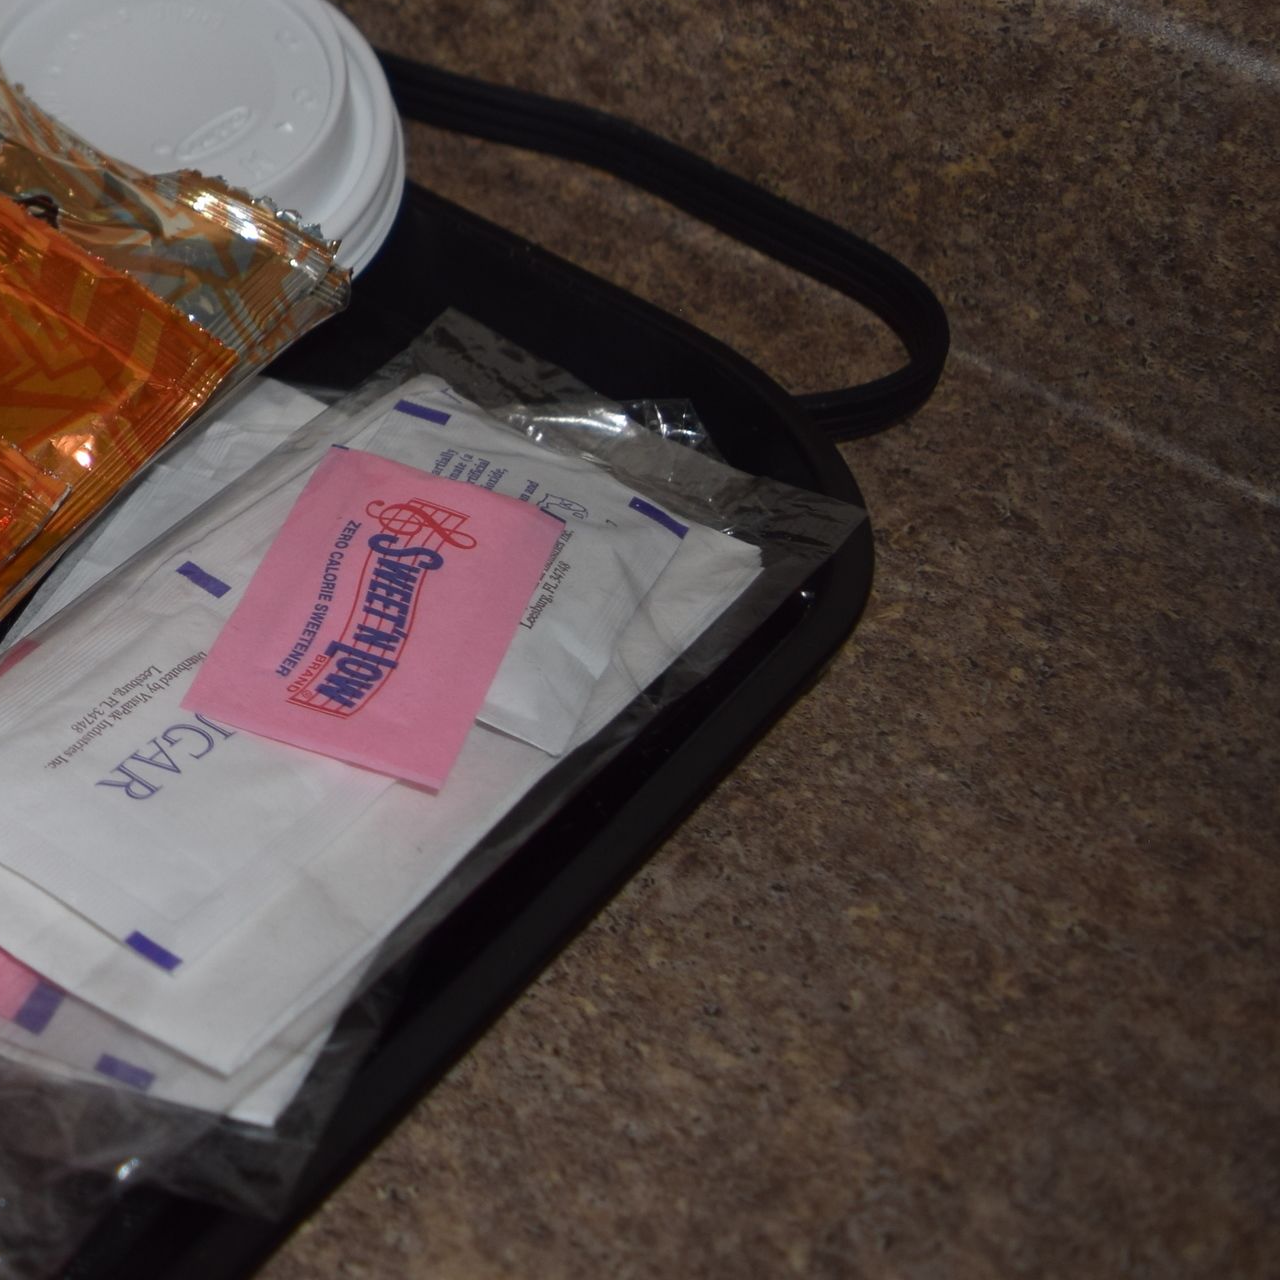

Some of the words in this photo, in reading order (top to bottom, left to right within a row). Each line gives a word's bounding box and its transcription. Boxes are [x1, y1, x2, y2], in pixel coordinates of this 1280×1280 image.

[432, 448, 458, 476] artially
[467, 458, 490, 484] rtificial
[334, 519, 362, 551] ZERO
[317, 549, 344, 602] CALORIE
[542, 582, 558, 594] FL
[550, 560, 571, 584] 34748
[275, 602, 329, 678] SWEETENER
[112, 665, 162, 697] Leesburg,
[147, 681, 164, 694] by
[287, 653, 327, 694] BRAND
[99, 696, 120, 709] FL
[70, 707, 104, 734] 34748
[63, 718, 115, 757] Industries
[44, 754, 69, 770] Inc.
[95, 712, 236, 800] GAR
